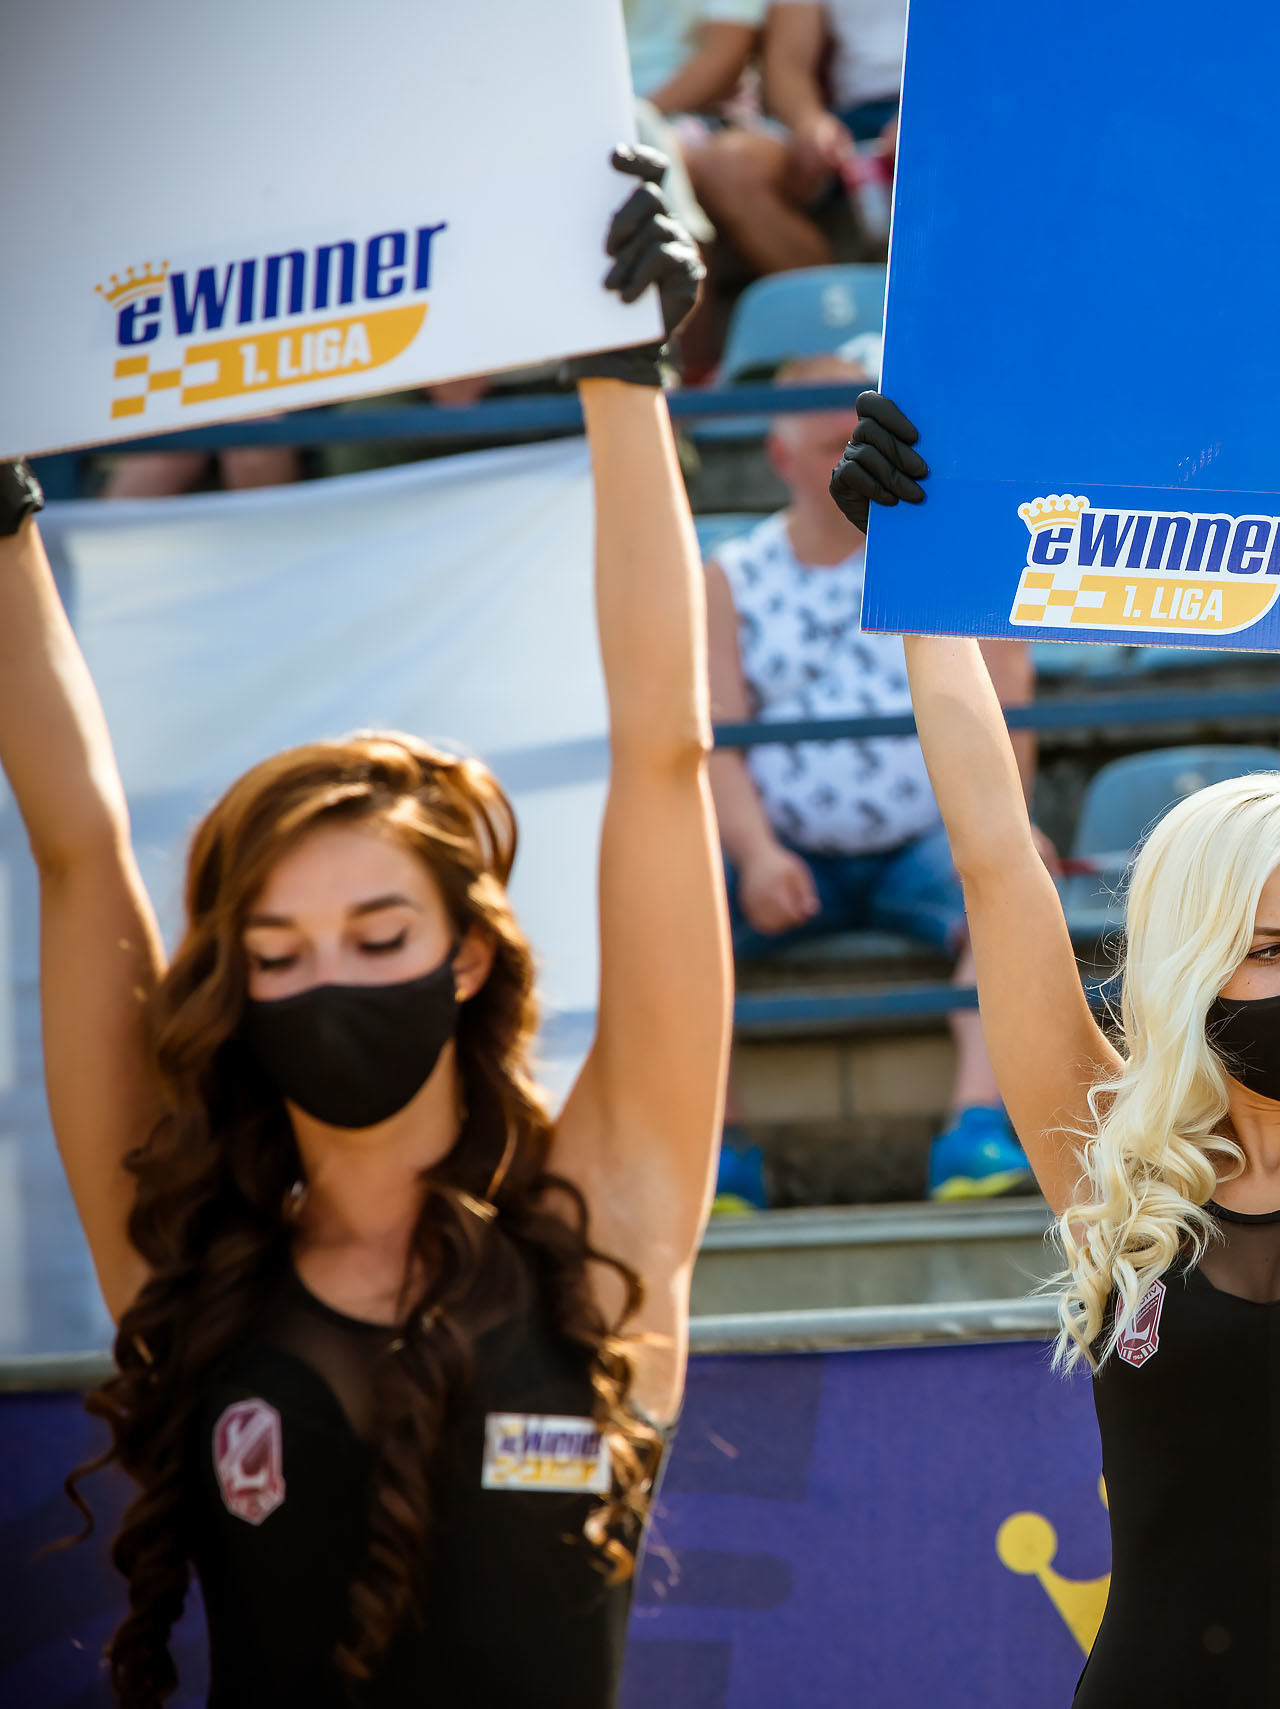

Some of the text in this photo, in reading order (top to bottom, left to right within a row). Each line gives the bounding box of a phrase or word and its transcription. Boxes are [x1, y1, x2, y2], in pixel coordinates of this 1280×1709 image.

[238, 323, 372, 386] 1. LIGA
[1123, 585, 1223, 622] 1. LIGA
